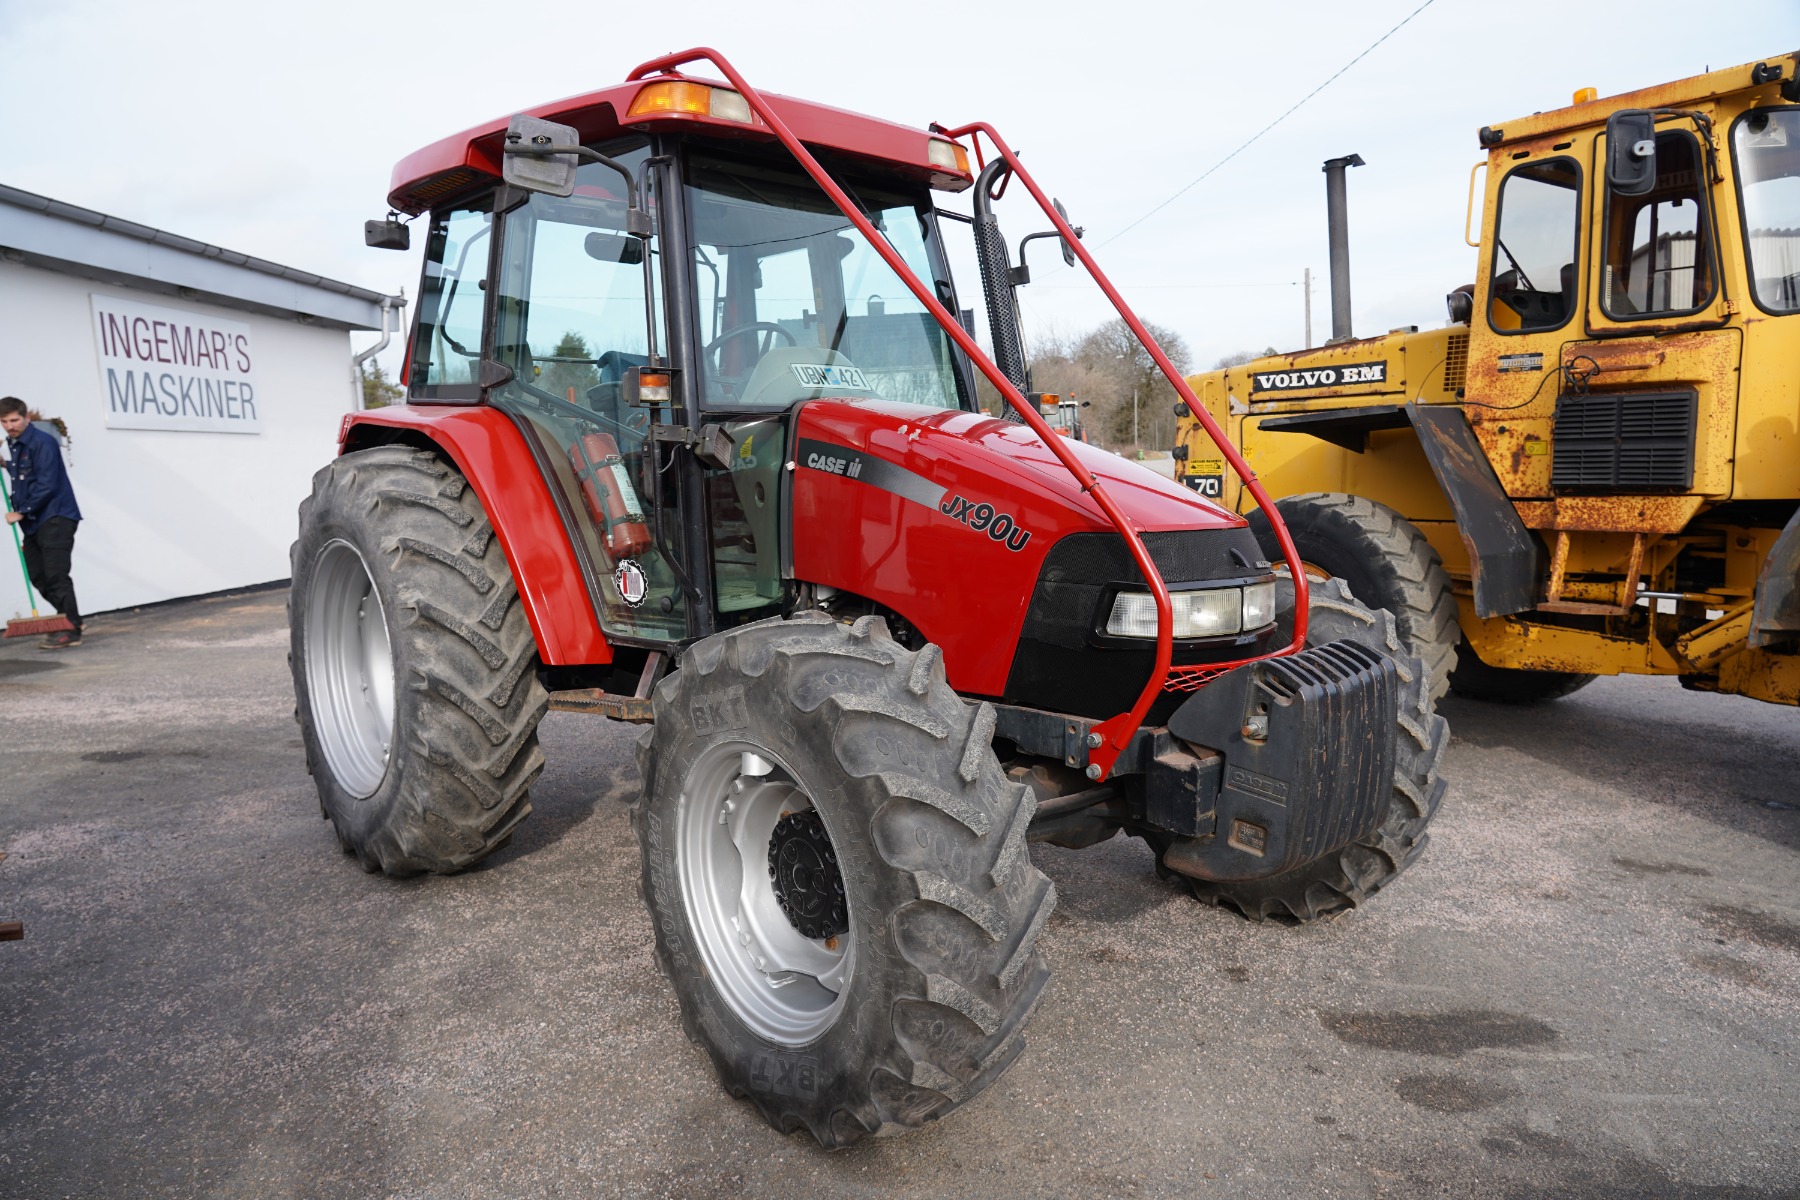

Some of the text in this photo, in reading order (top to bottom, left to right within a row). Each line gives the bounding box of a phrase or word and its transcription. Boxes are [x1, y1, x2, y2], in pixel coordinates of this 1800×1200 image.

[98, 311, 251, 373] INGEMAR'S
[107, 368, 257, 420] MASKINER
[794, 366, 867, 388] UBN 421
[1257, 365, 1384, 389] VOLVO BM
[807, 452, 846, 475] CASE
[1194, 478, 1219, 495] 70
[941, 495, 1033, 552] JX90U
[690, 694, 746, 732] BKT
[751, 1056, 816, 1092] BKT
